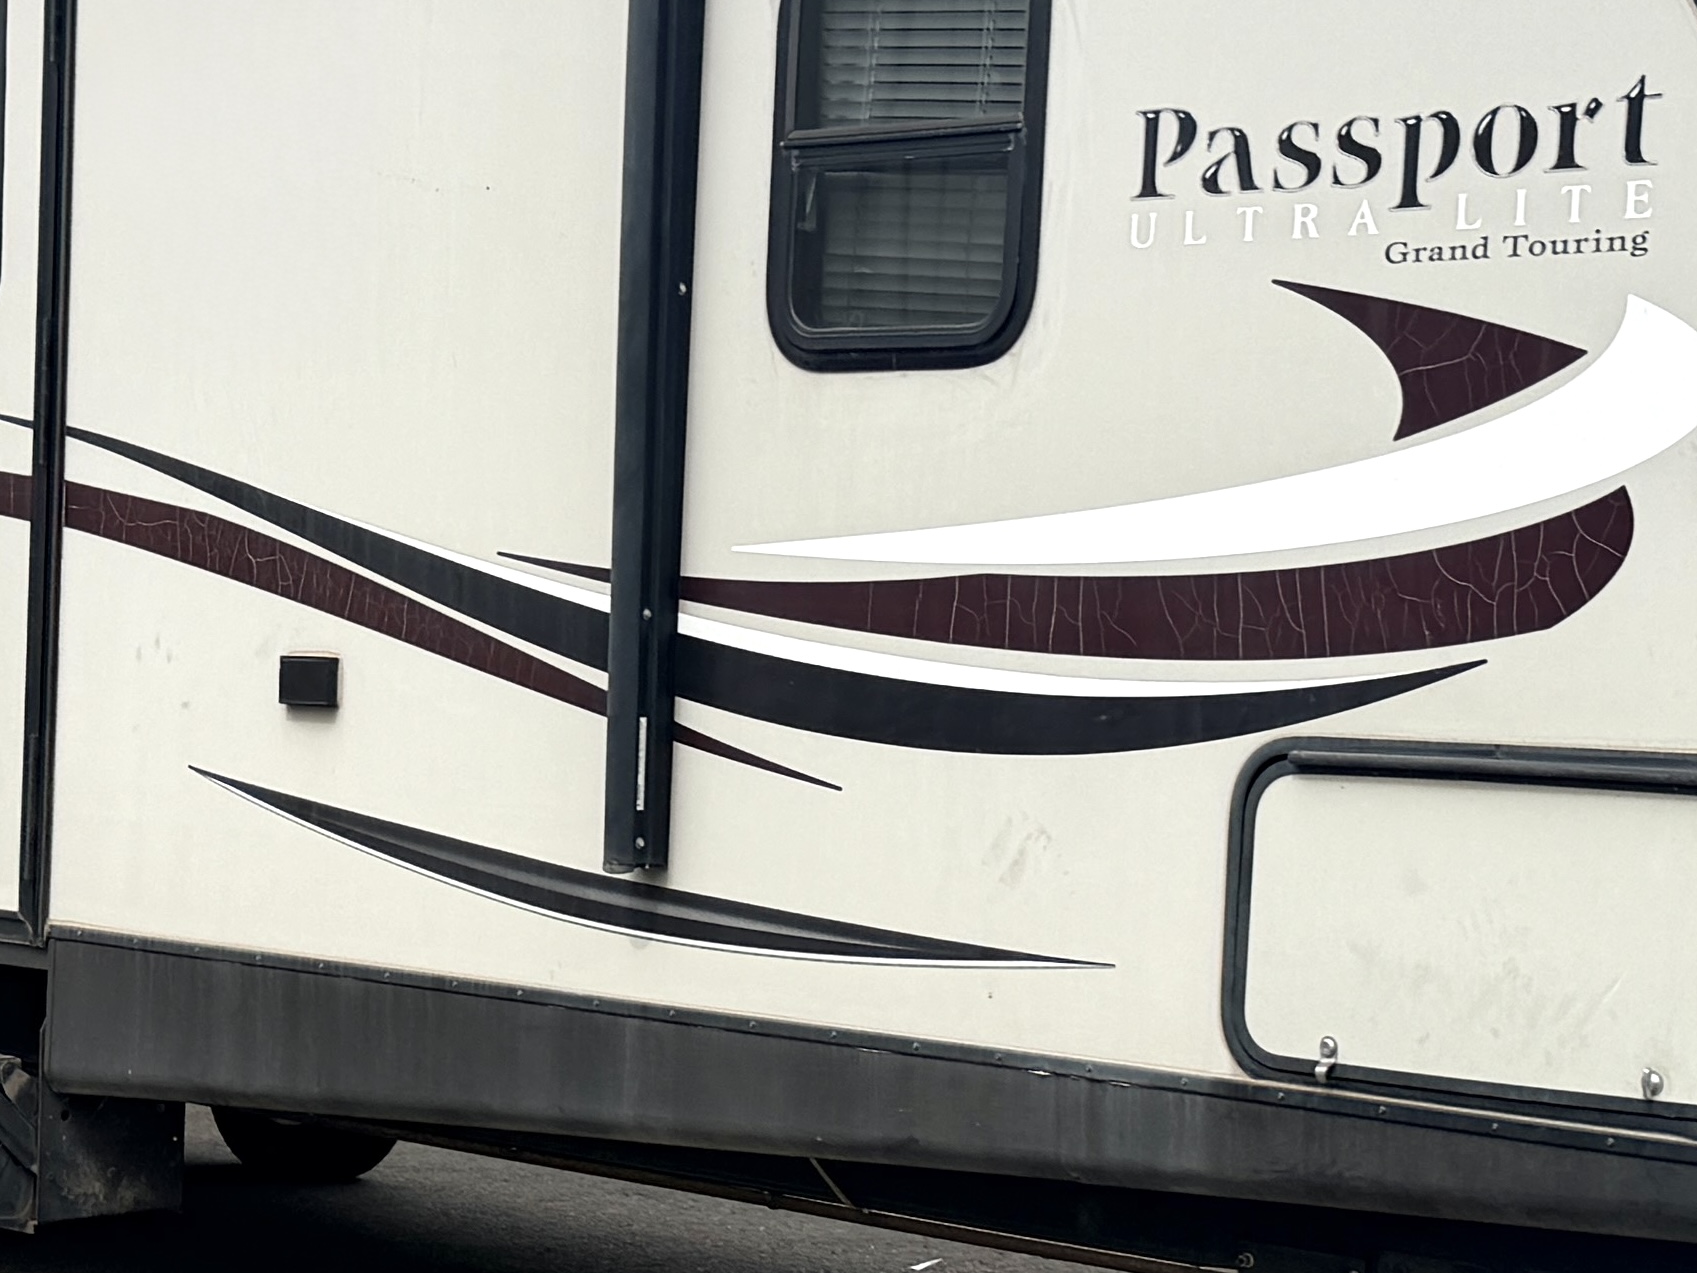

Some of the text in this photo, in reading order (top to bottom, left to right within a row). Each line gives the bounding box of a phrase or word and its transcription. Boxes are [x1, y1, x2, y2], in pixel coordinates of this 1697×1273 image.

[1129, 73, 1664, 213] Passport
[1129, 179, 1654, 248] ULTRA LITE
[1384, 229, 1651, 266] Grand Touring
